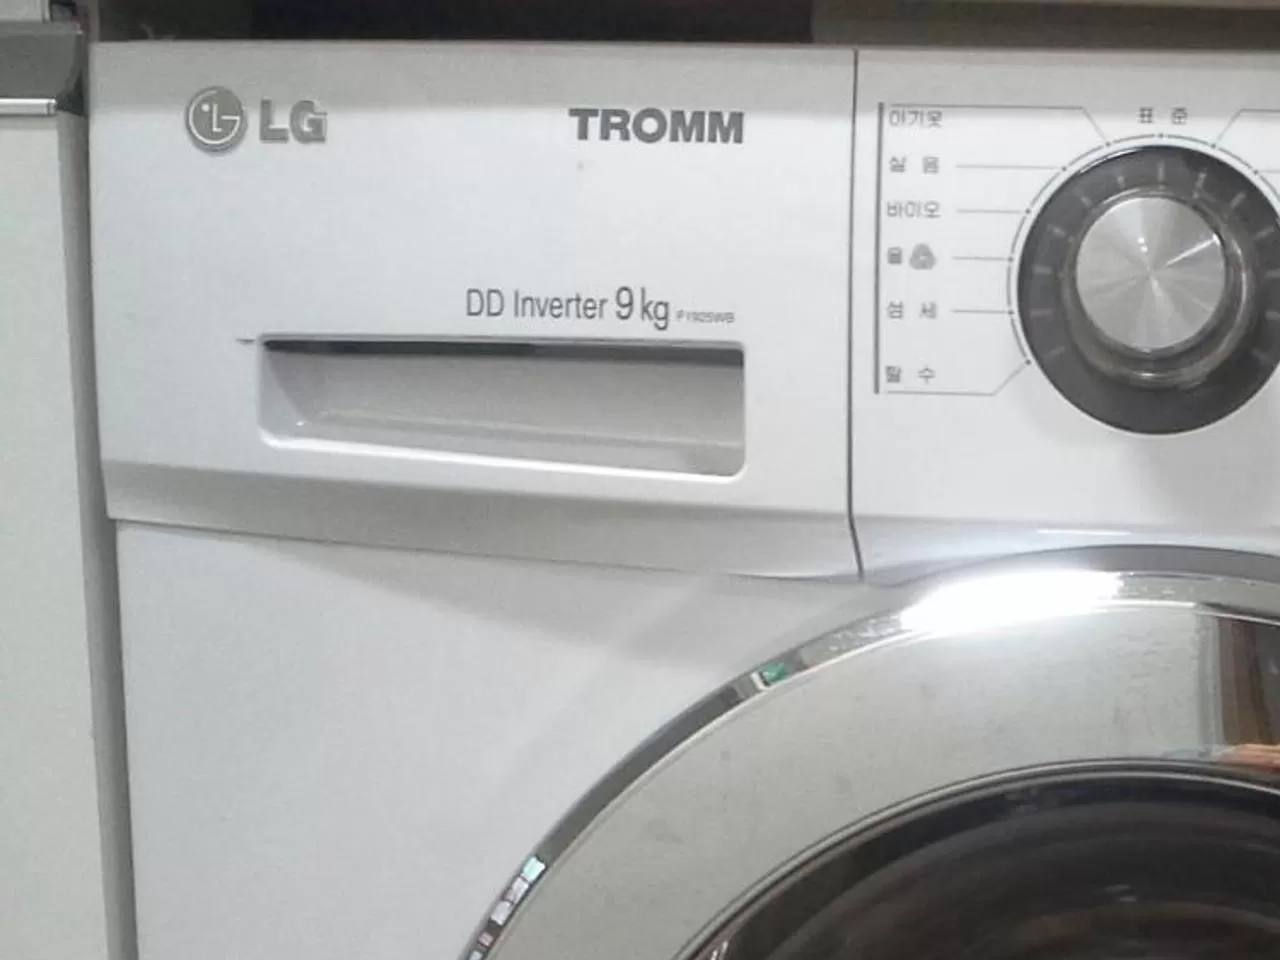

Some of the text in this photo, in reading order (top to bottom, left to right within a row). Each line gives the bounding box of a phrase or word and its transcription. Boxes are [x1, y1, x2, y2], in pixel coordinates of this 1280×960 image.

[259, 99, 328, 144] LG
[568, 107, 744, 145] TROMM
[887, 200, 941, 219] 바이오
[466, 287, 505, 318] DD
[513, 289, 608, 320] Inverter
[615, 286, 634, 321] 9
[641, 287, 670, 331] kg
